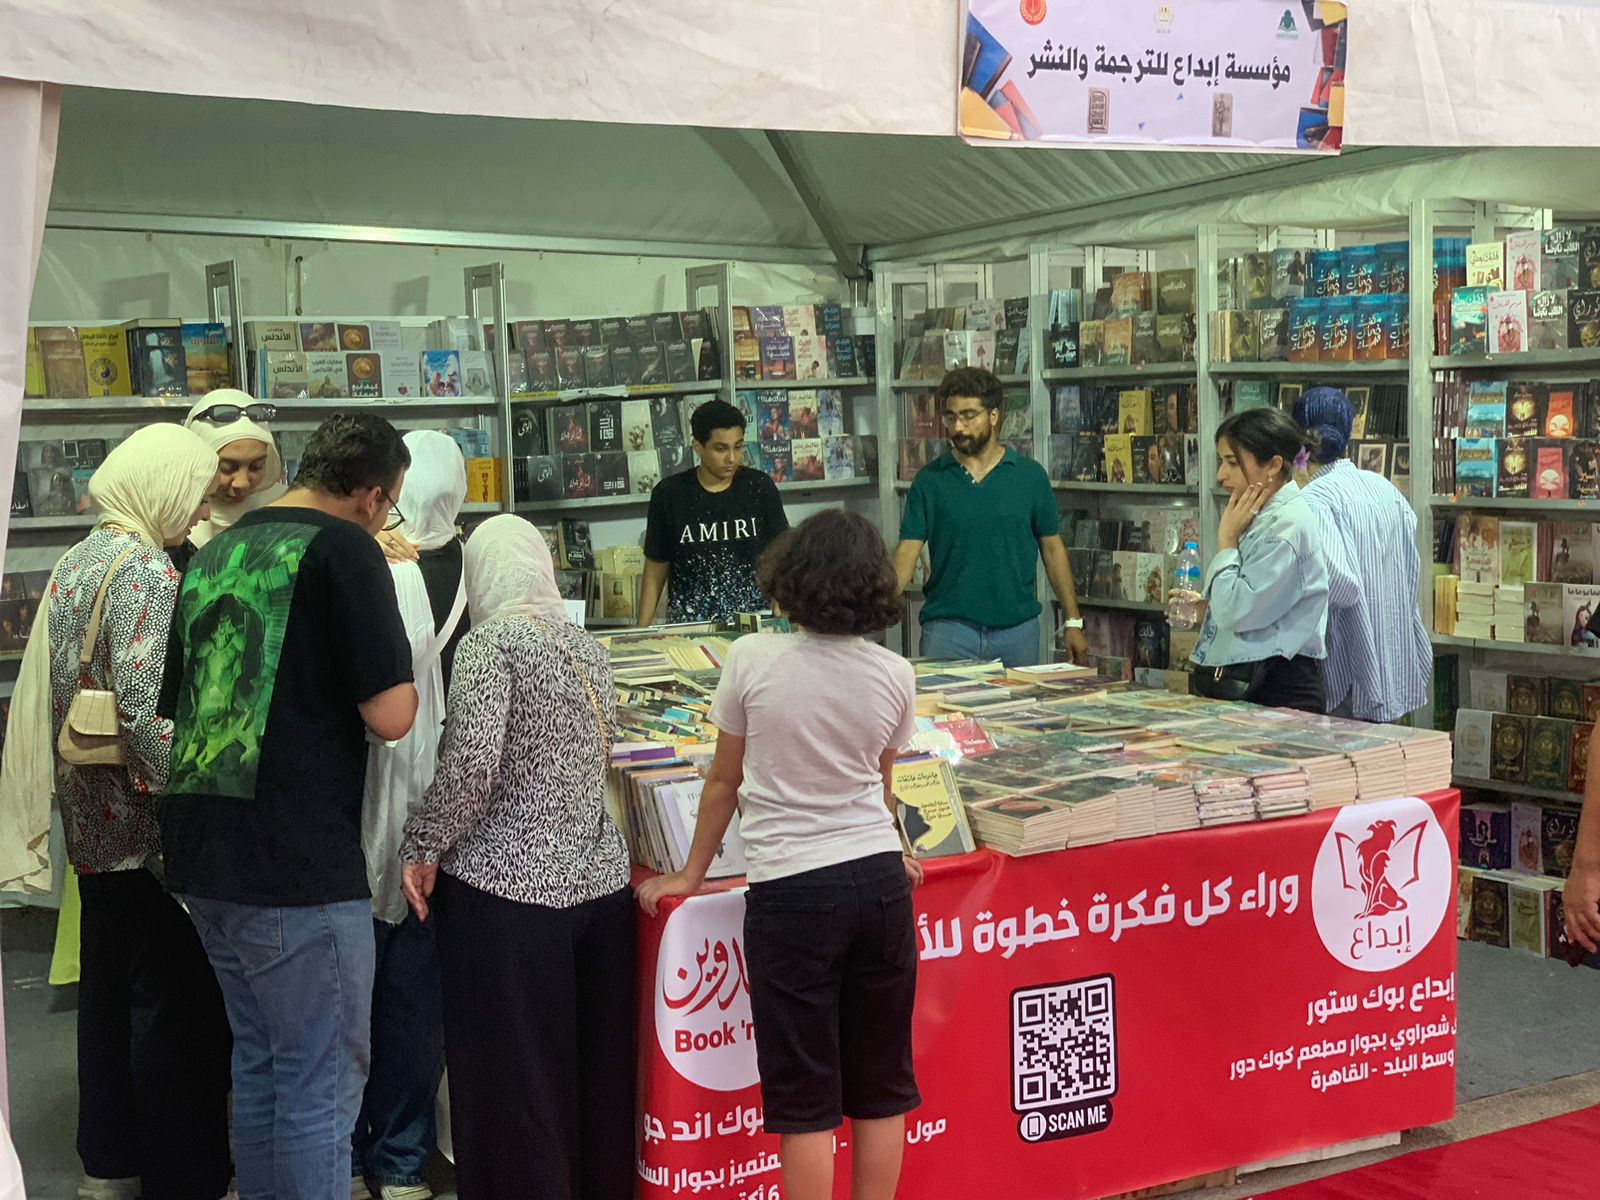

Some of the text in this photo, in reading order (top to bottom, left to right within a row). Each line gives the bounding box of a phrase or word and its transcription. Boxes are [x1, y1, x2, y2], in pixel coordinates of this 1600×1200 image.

[1027, 39, 1291, 90] مؤسسة إبداع للترجمة والنشر
[261, 331, 292, 342] الأندلس
[273, 363, 303, 375] الأندلس
[679, 517, 758, 544] AMIRI
[917, 871, 1299, 961] وراء كل فكرة خطوة للأ
[1350, 916, 1412, 960] إبداع
[1306, 971, 1455, 1026] إبداع بوك ستور
[675, 1021, 737, 1053] Book
[1350, 1032, 1387, 1057] بجوار
[1389, 1014, 1450, 1051] شعراوي
[1230, 1057, 1256, 1080] دور
[1258, 1045, 1294, 1071] كوك
[1296, 1039, 1347, 1069] مطعم
[1383, 1053, 1418, 1077] البلد
[1420, 1048, 1455, 1071] وسط
[1311, 1062, 1369, 1093] القاهرة
[671, 1112, 711, 1141] اند
[717, 1104, 764, 1137] وك
[906, 1118, 947, 1144] مول
[1048, 1104, 1108, 1133] SCAN ME
[672, 1167, 725, 1195] بجوار
[728, 1151, 782, 1187] متميز
